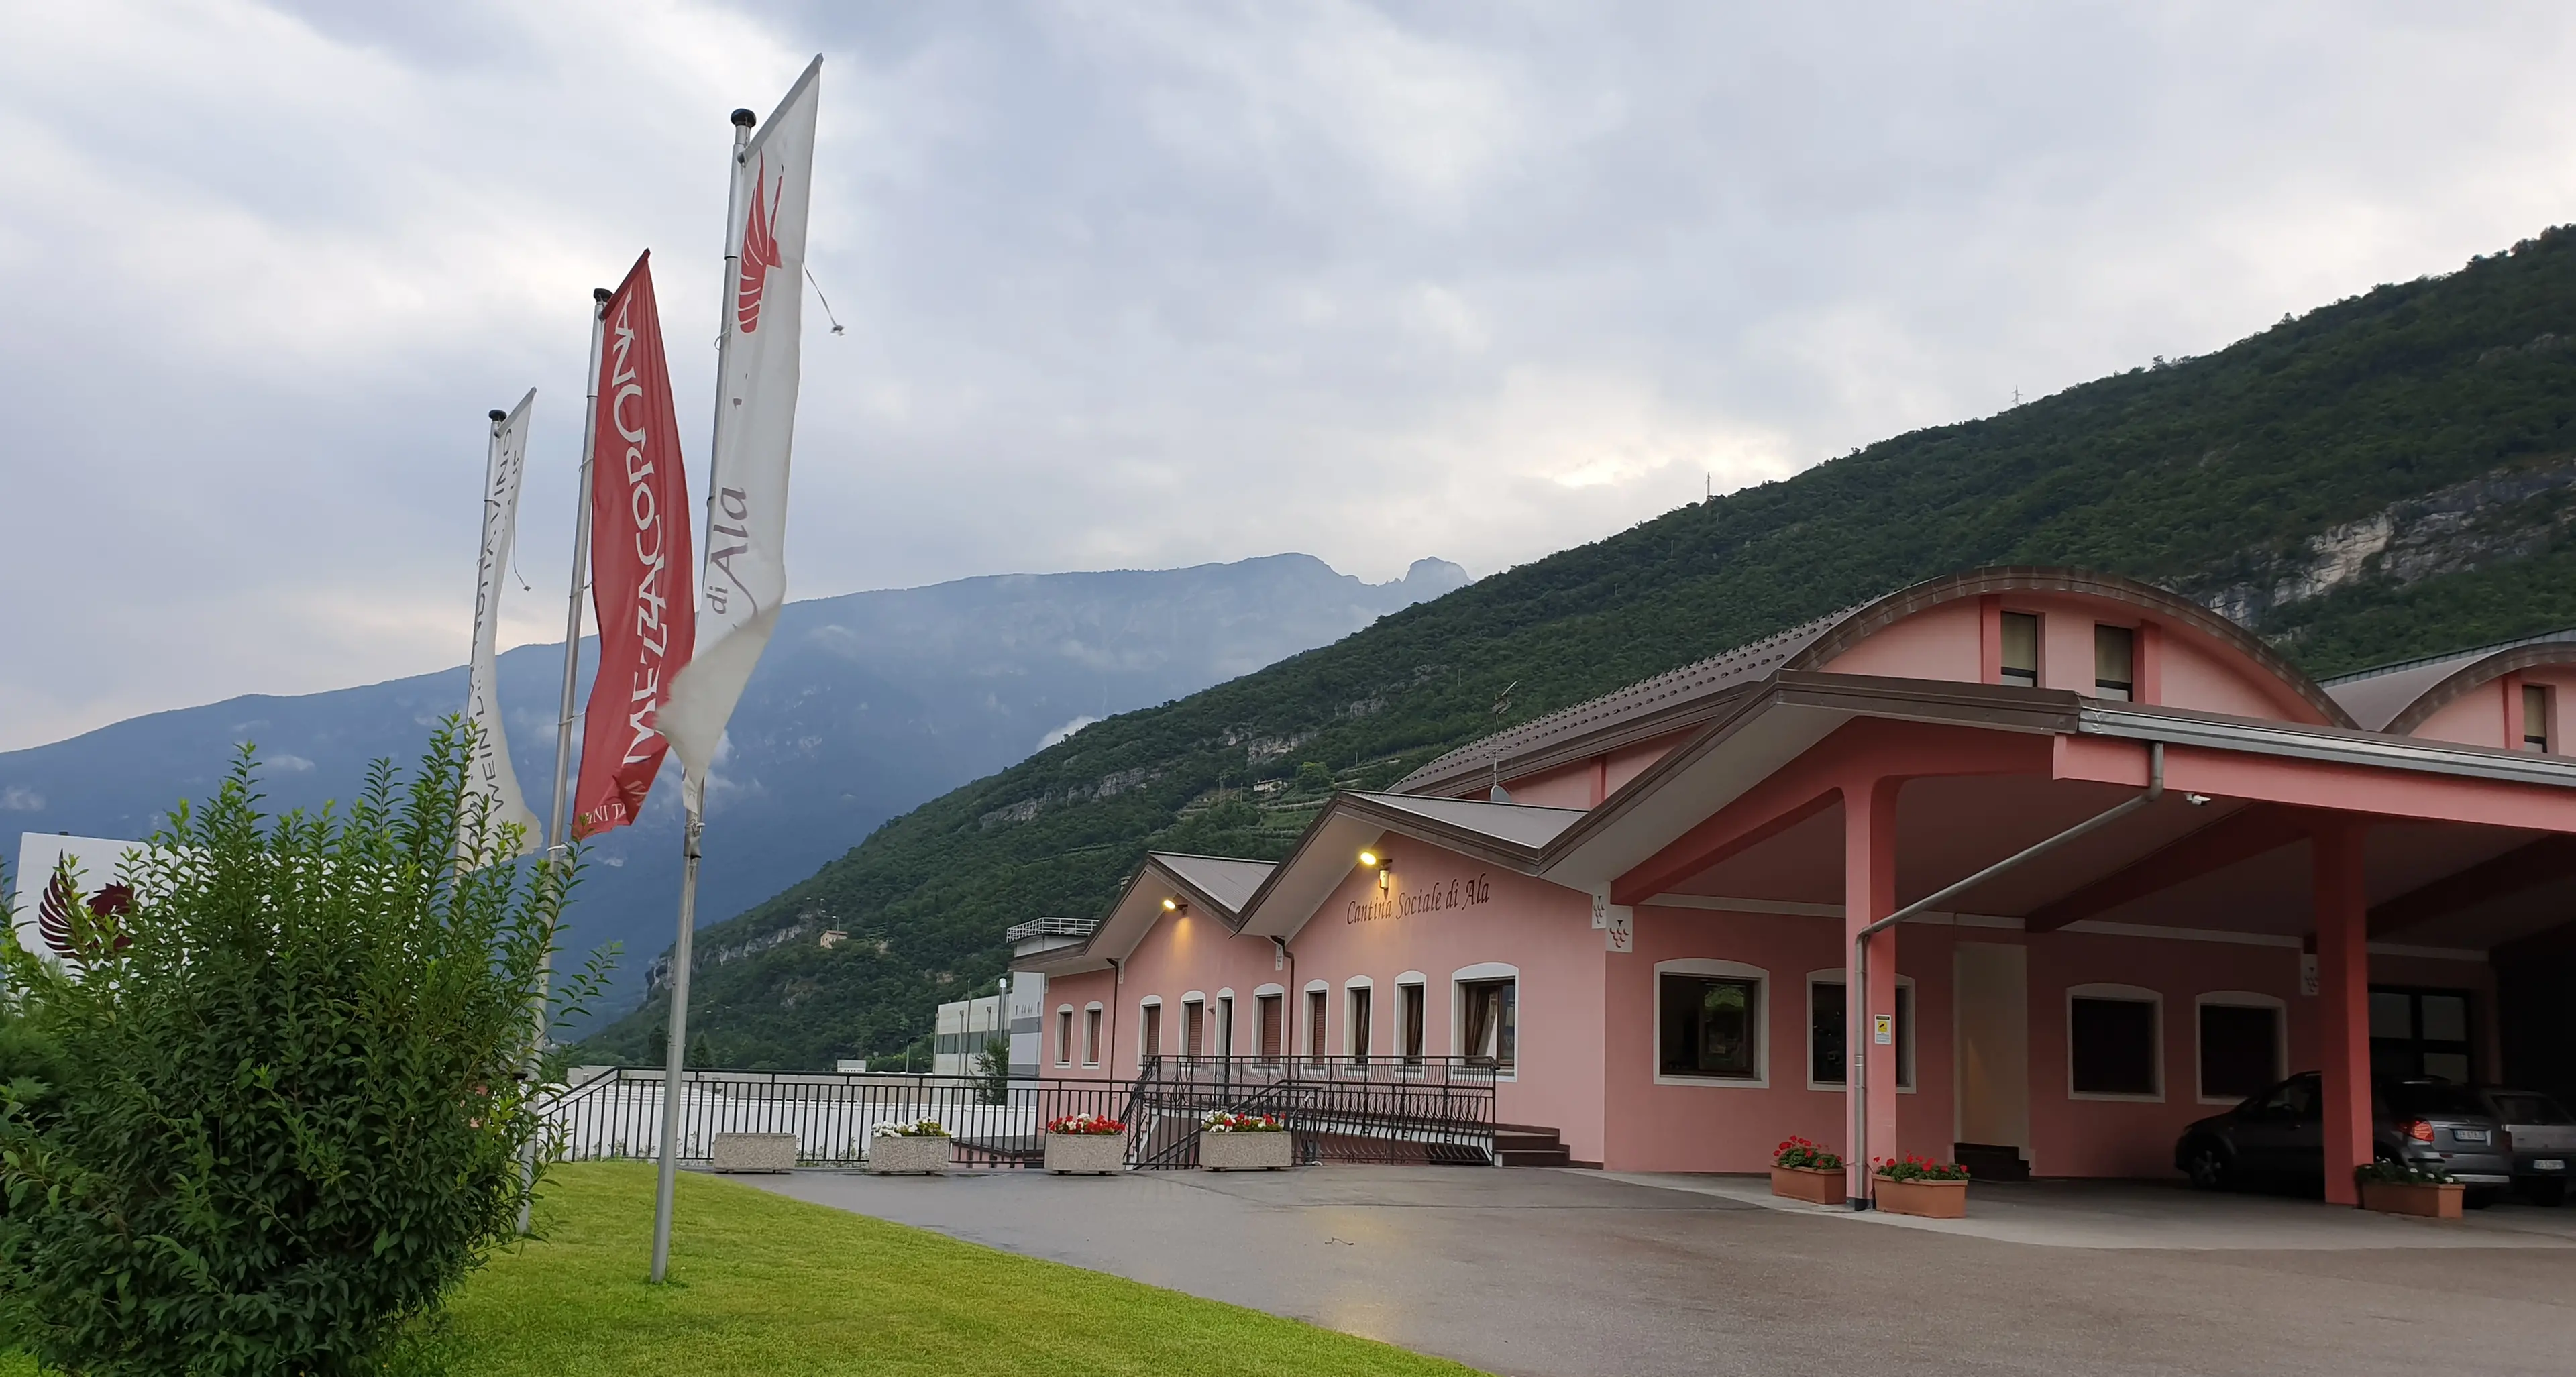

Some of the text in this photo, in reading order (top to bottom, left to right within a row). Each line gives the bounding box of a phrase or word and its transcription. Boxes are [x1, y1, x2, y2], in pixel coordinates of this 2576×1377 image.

[611, 283, 667, 768] MEZZACORONA
[706, 487, 759, 618] di Ala
[476, 727, 504, 812] WEIN
[1346, 873, 1490, 925] Cantina Sociale di Ala
